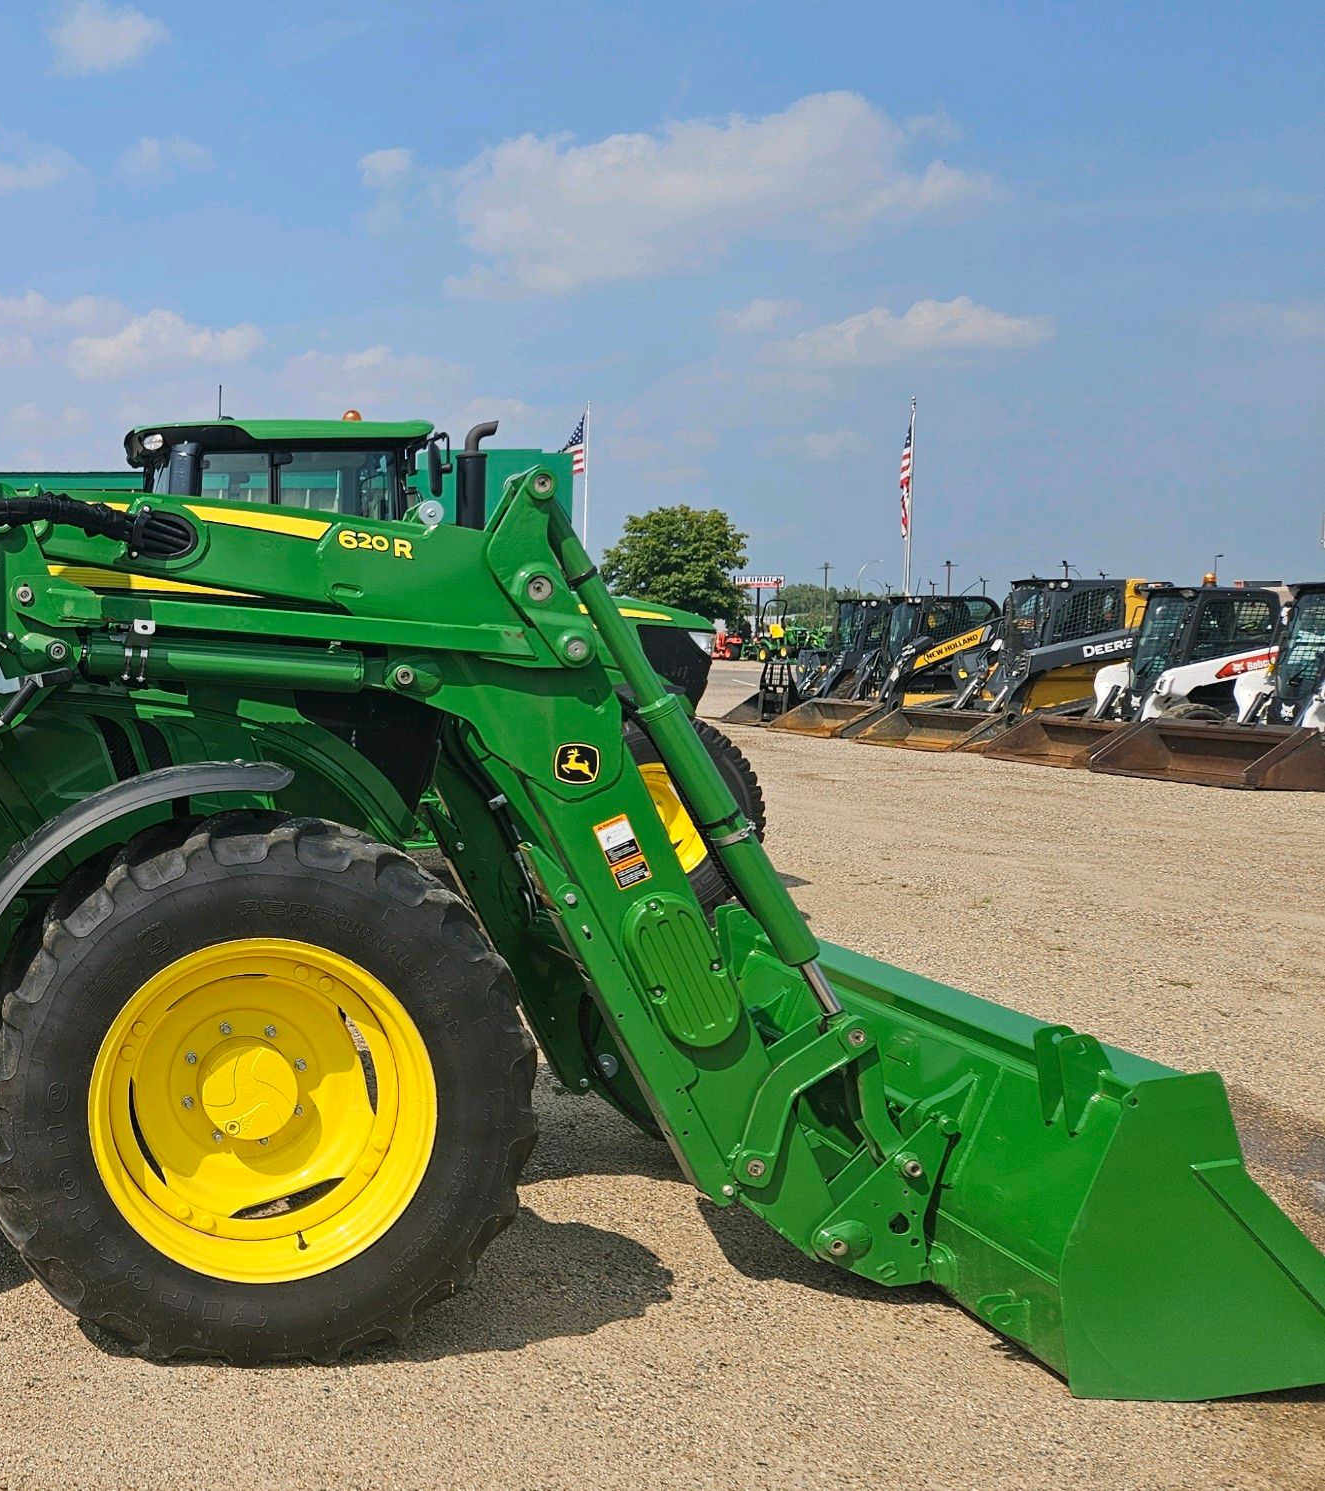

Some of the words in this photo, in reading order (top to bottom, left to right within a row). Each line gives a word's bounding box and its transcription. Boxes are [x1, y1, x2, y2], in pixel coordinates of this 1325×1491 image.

[338, 529, 390, 552] 620
[393, 538, 414, 560] R
[926, 648, 943, 660] NEW
[944, 634, 978, 654] HOLLAND
